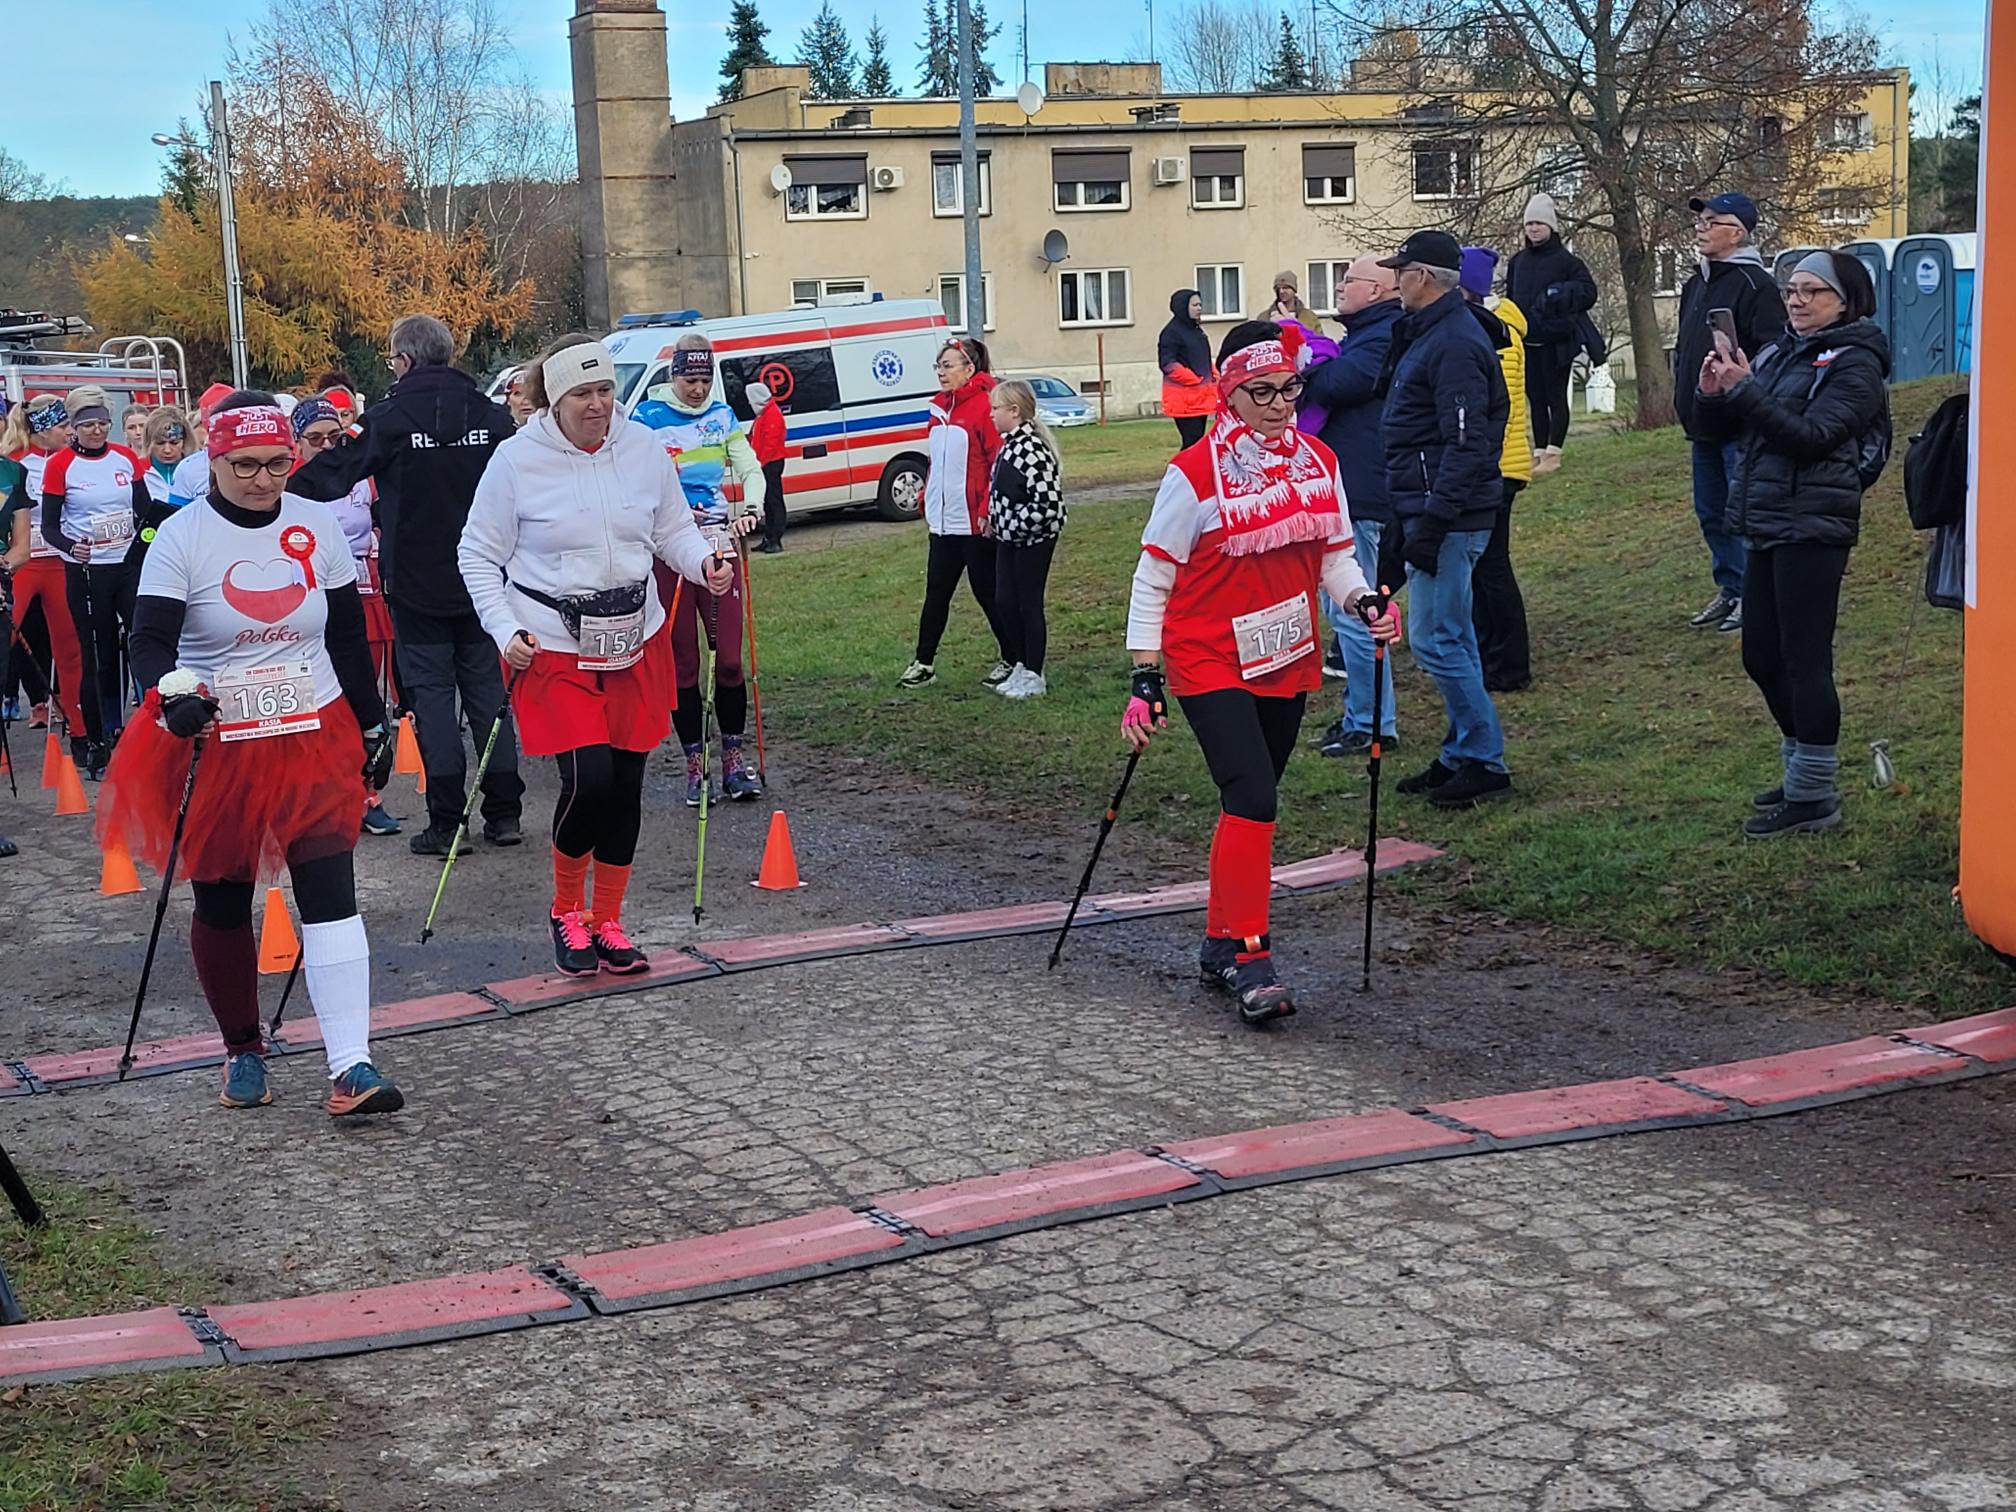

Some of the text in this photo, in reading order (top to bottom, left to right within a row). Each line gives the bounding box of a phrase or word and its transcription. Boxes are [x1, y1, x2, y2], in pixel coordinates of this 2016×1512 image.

[1250, 355, 1280, 368] HERO
[769, 371, 785, 393] P
[240, 423, 276, 434] HERO
[411, 429, 489, 449] REREE
[102, 520, 129, 540] 198
[235, 625, 301, 648] Polska
[594, 627, 641, 657] 152
[1251, 612, 1302, 657] 175
[233, 683, 299, 720] 163
[258, 718, 282, 728] KASIA
